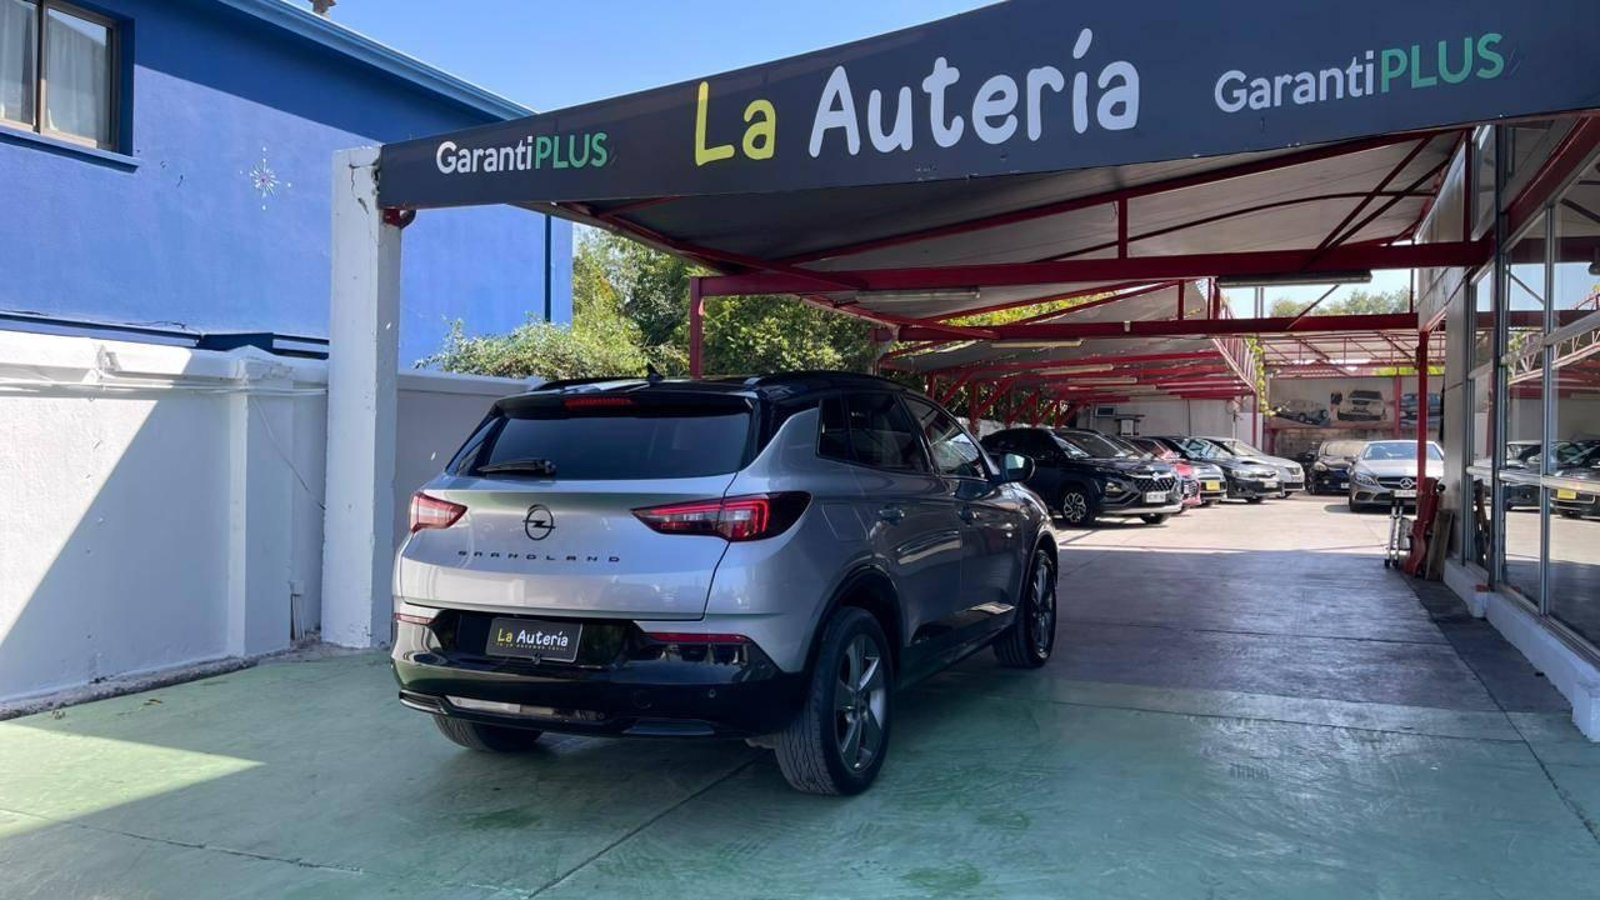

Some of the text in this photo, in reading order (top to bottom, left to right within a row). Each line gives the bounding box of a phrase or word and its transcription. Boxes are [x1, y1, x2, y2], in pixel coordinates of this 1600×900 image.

[1214, 33, 1505, 113] GarantiPLUS
[695, 28, 1140, 166] La Autería
[436, 132, 608, 174] GarantiPLUS
[458, 550, 620, 562] GRANDLAND
[497, 628, 569, 646] La Autería
